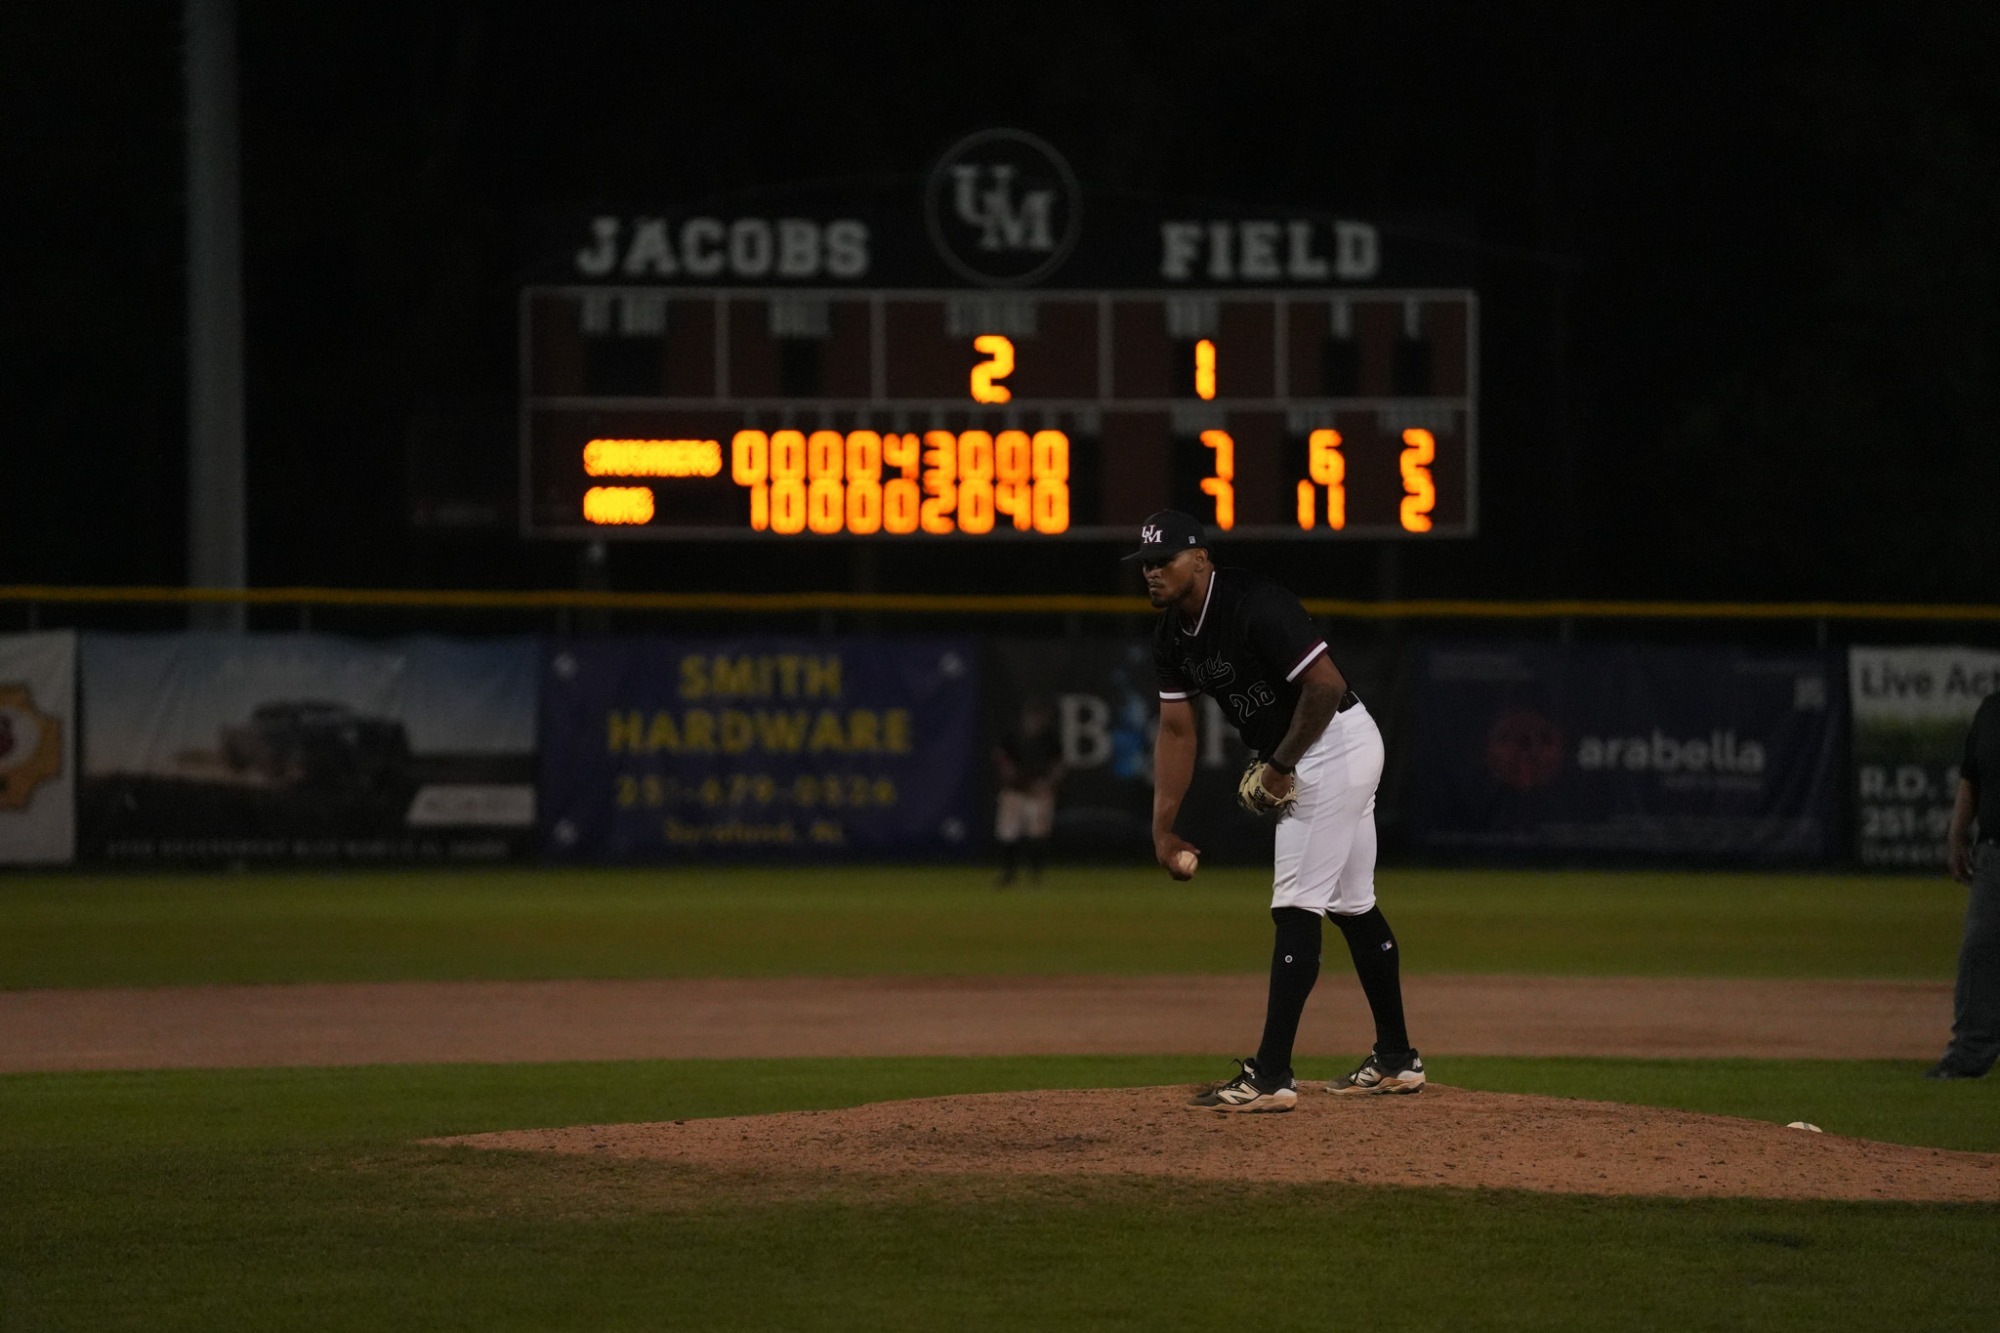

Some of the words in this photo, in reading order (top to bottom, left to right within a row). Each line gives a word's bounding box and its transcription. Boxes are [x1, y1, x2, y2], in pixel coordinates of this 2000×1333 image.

[953, 163, 1054, 251] UM
[576, 216, 870, 278] JACOBS
[1160, 220, 1381, 280] FIELD
[970, 335, 1015, 404] 2
[1194, 339, 1217, 401] 1
[1200, 429, 1235, 482] 7
[1308, 428, 1346, 484] 6
[1200, 477, 1235, 532] 7
[1297, 478, 1346, 531] 11
[1141, 524, 1163, 544] UM
[679, 654, 843, 697] SMITH
[1860, 662, 1932, 698] Live
[607, 709, 911, 754] HARDWARE
[1577, 729, 1767, 774] arabella
